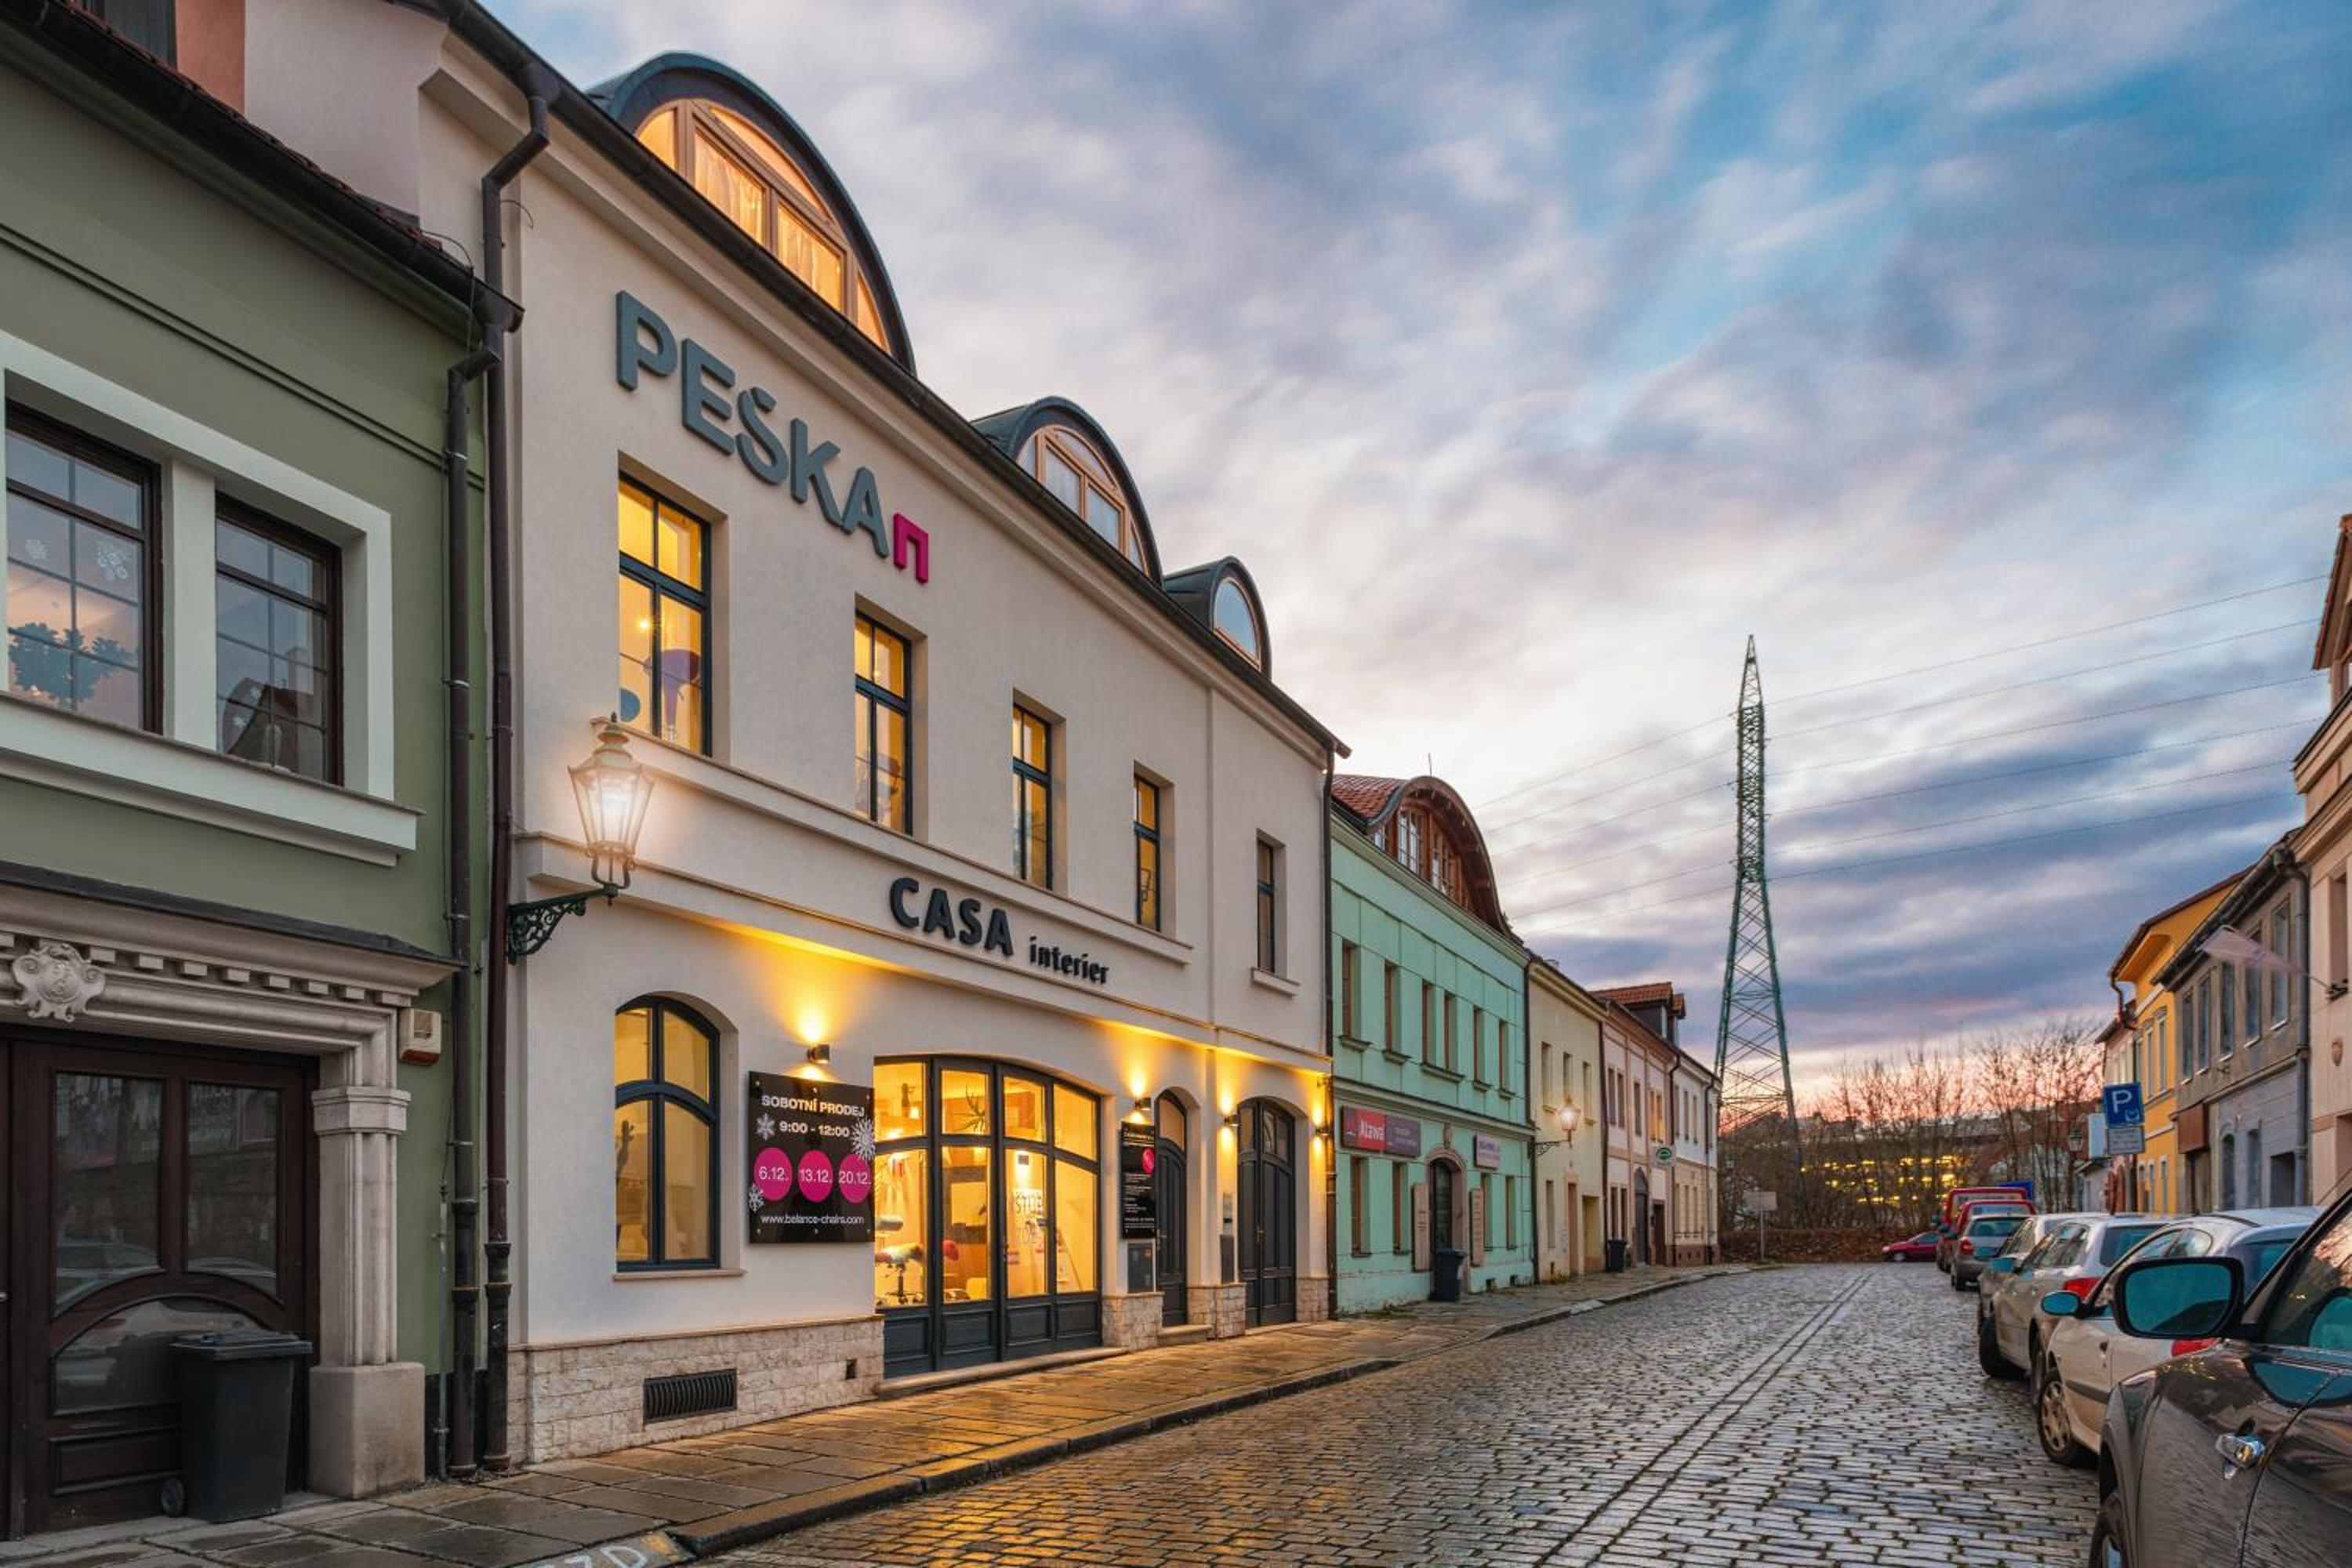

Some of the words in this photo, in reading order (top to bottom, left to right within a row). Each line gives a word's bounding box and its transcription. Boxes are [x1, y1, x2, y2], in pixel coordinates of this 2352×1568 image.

[889, 877, 1014, 957] CASA
[761, 1095, 817, 1112] SOBOTNÍ
[819, 1102, 865, 1117] PRODEJ
[2111, 1089, 2132, 1113] P
[779, 1121, 808, 1134] 9:00
[818, 1125, 850, 1137] 12:00
[759, 1166, 789, 1181] 6.12.
[798, 1169, 833, 1183] 13.12.
[838, 1171, 872, 1185] 20.12.
